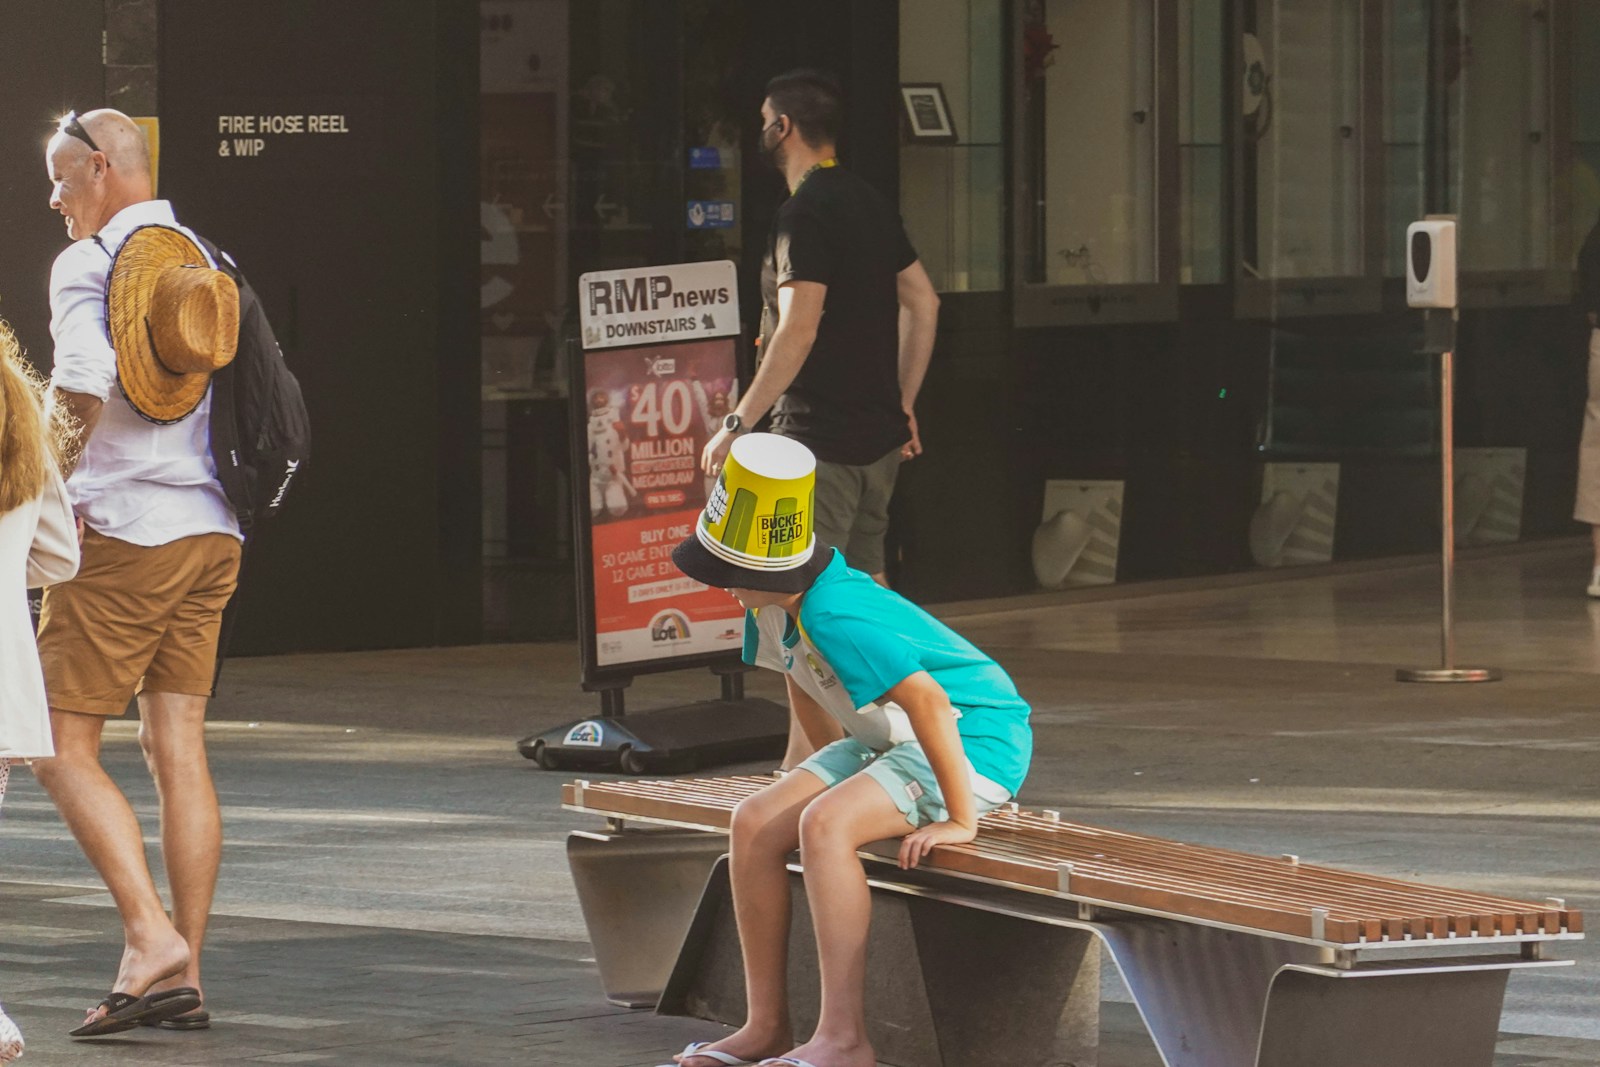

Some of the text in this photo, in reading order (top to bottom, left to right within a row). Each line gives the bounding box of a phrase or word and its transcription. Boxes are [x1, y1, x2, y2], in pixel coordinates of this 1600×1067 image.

[218, 114, 349, 134] FIRE HOSE REEL
[218, 138, 265, 157] & WIP
[605, 316, 697, 339] DOWNSTAIRS
[631, 437, 695, 460] MILLION
[760, 510, 804, 530] BUCKET
[640, 524, 691, 545] BUY ONE
[769, 524, 803, 545] HEAD
[601, 553, 616, 569] 50
[617, 548, 647, 566] GAME
[612, 569, 625, 584] 12
[626, 563, 656, 581] GAME
